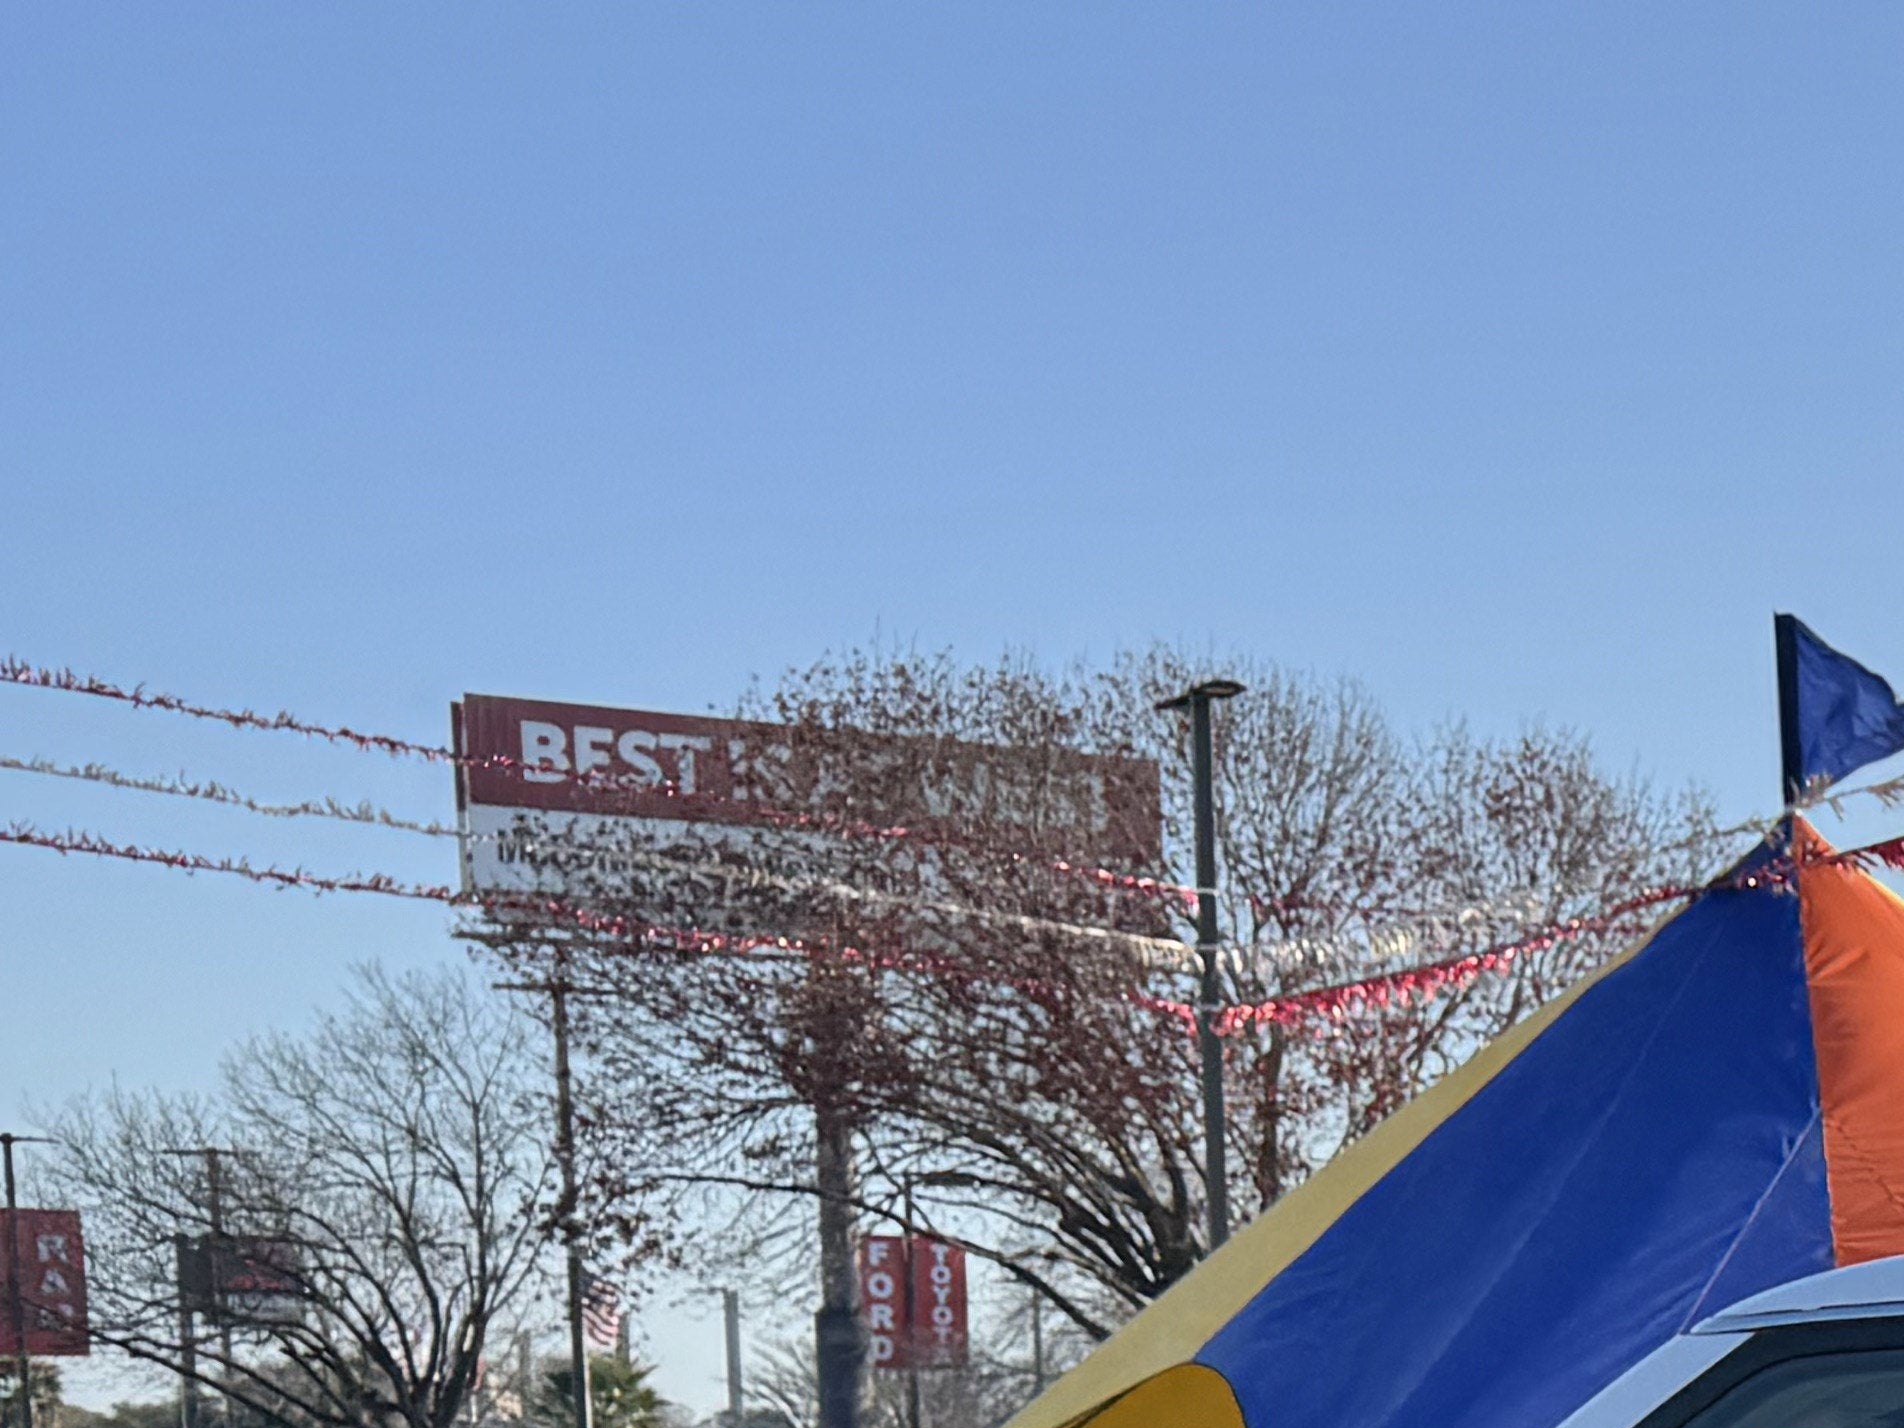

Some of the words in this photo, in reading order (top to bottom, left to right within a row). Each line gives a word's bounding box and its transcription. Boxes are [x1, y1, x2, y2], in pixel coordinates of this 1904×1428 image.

[520, 719, 712, 796] BEST
[866, 1241, 895, 1361] FORD
[929, 1242, 954, 1366] TOYOT
